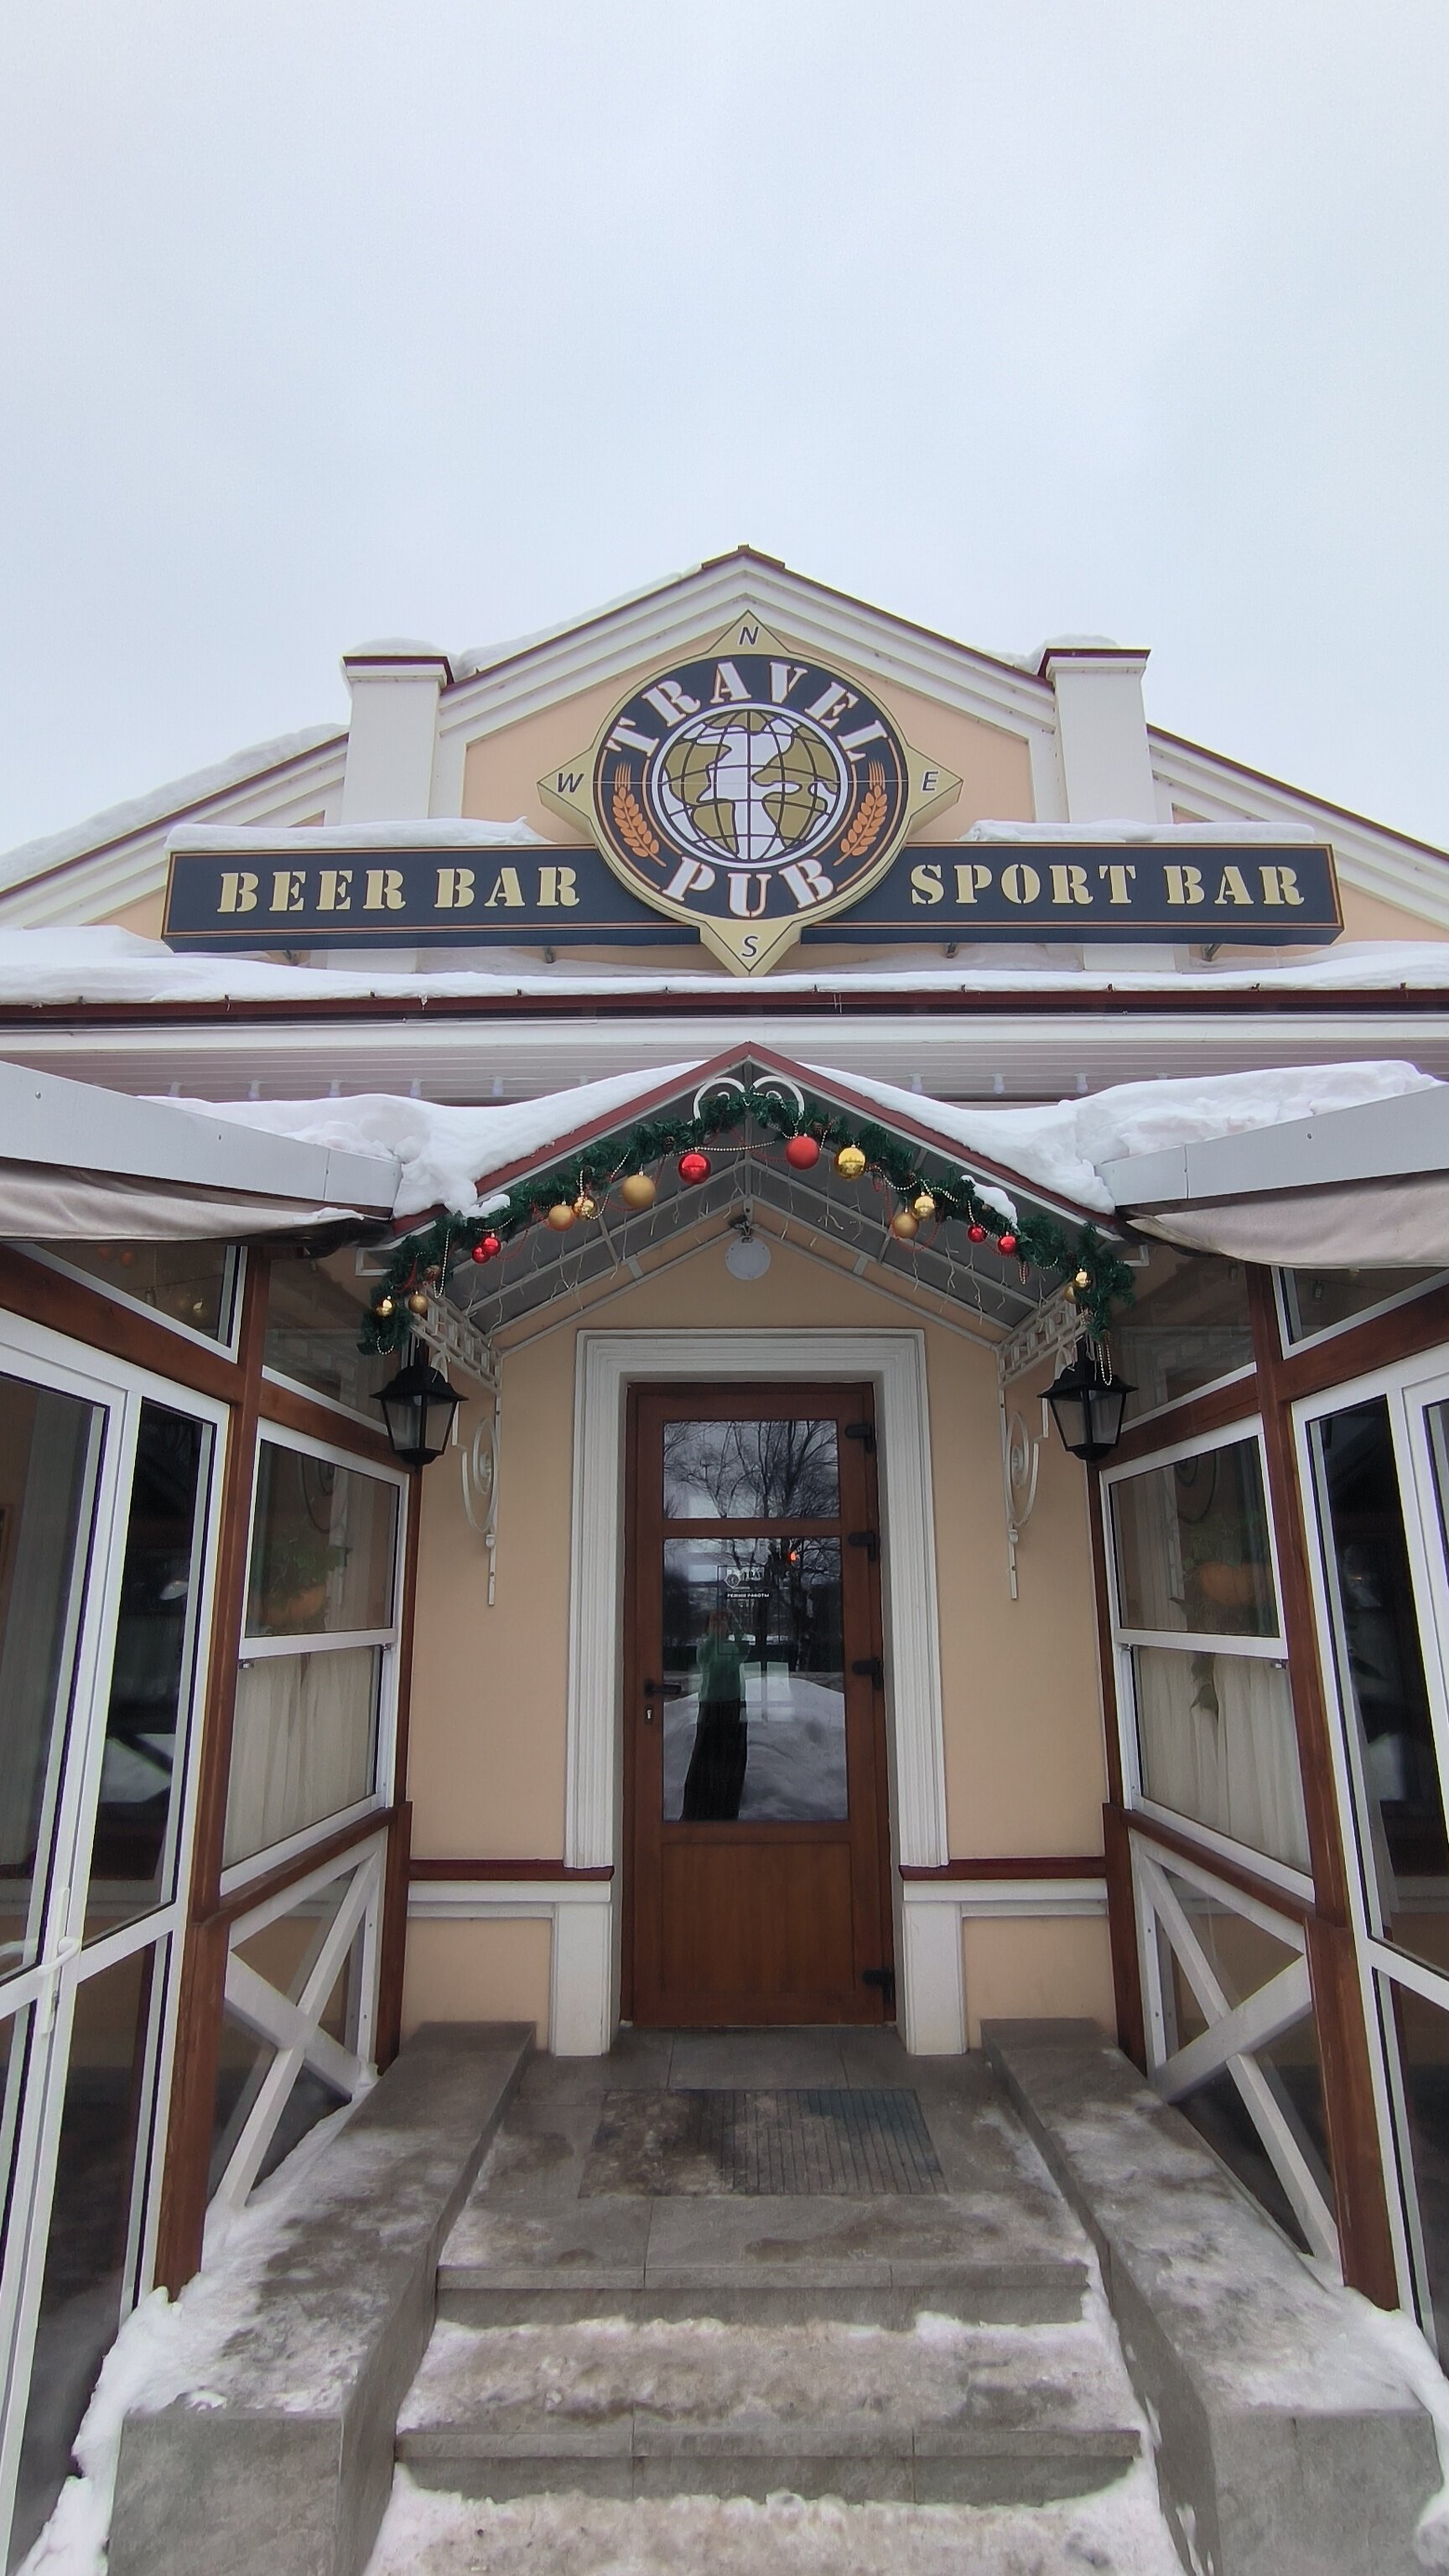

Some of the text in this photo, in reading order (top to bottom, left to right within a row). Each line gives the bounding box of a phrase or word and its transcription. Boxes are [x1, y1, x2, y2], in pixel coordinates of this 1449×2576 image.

[739, 626, 759, 646] N
[604, 661, 889, 762] TRAVEL
[558, 772, 584, 793] W
[922, 771, 939, 792] E
[216, 866, 580, 913] BEER BAR
[662, 855, 834, 918] PUB
[910, 864, 1305, 906] SPORT BAR
[741, 935, 759, 958] S
